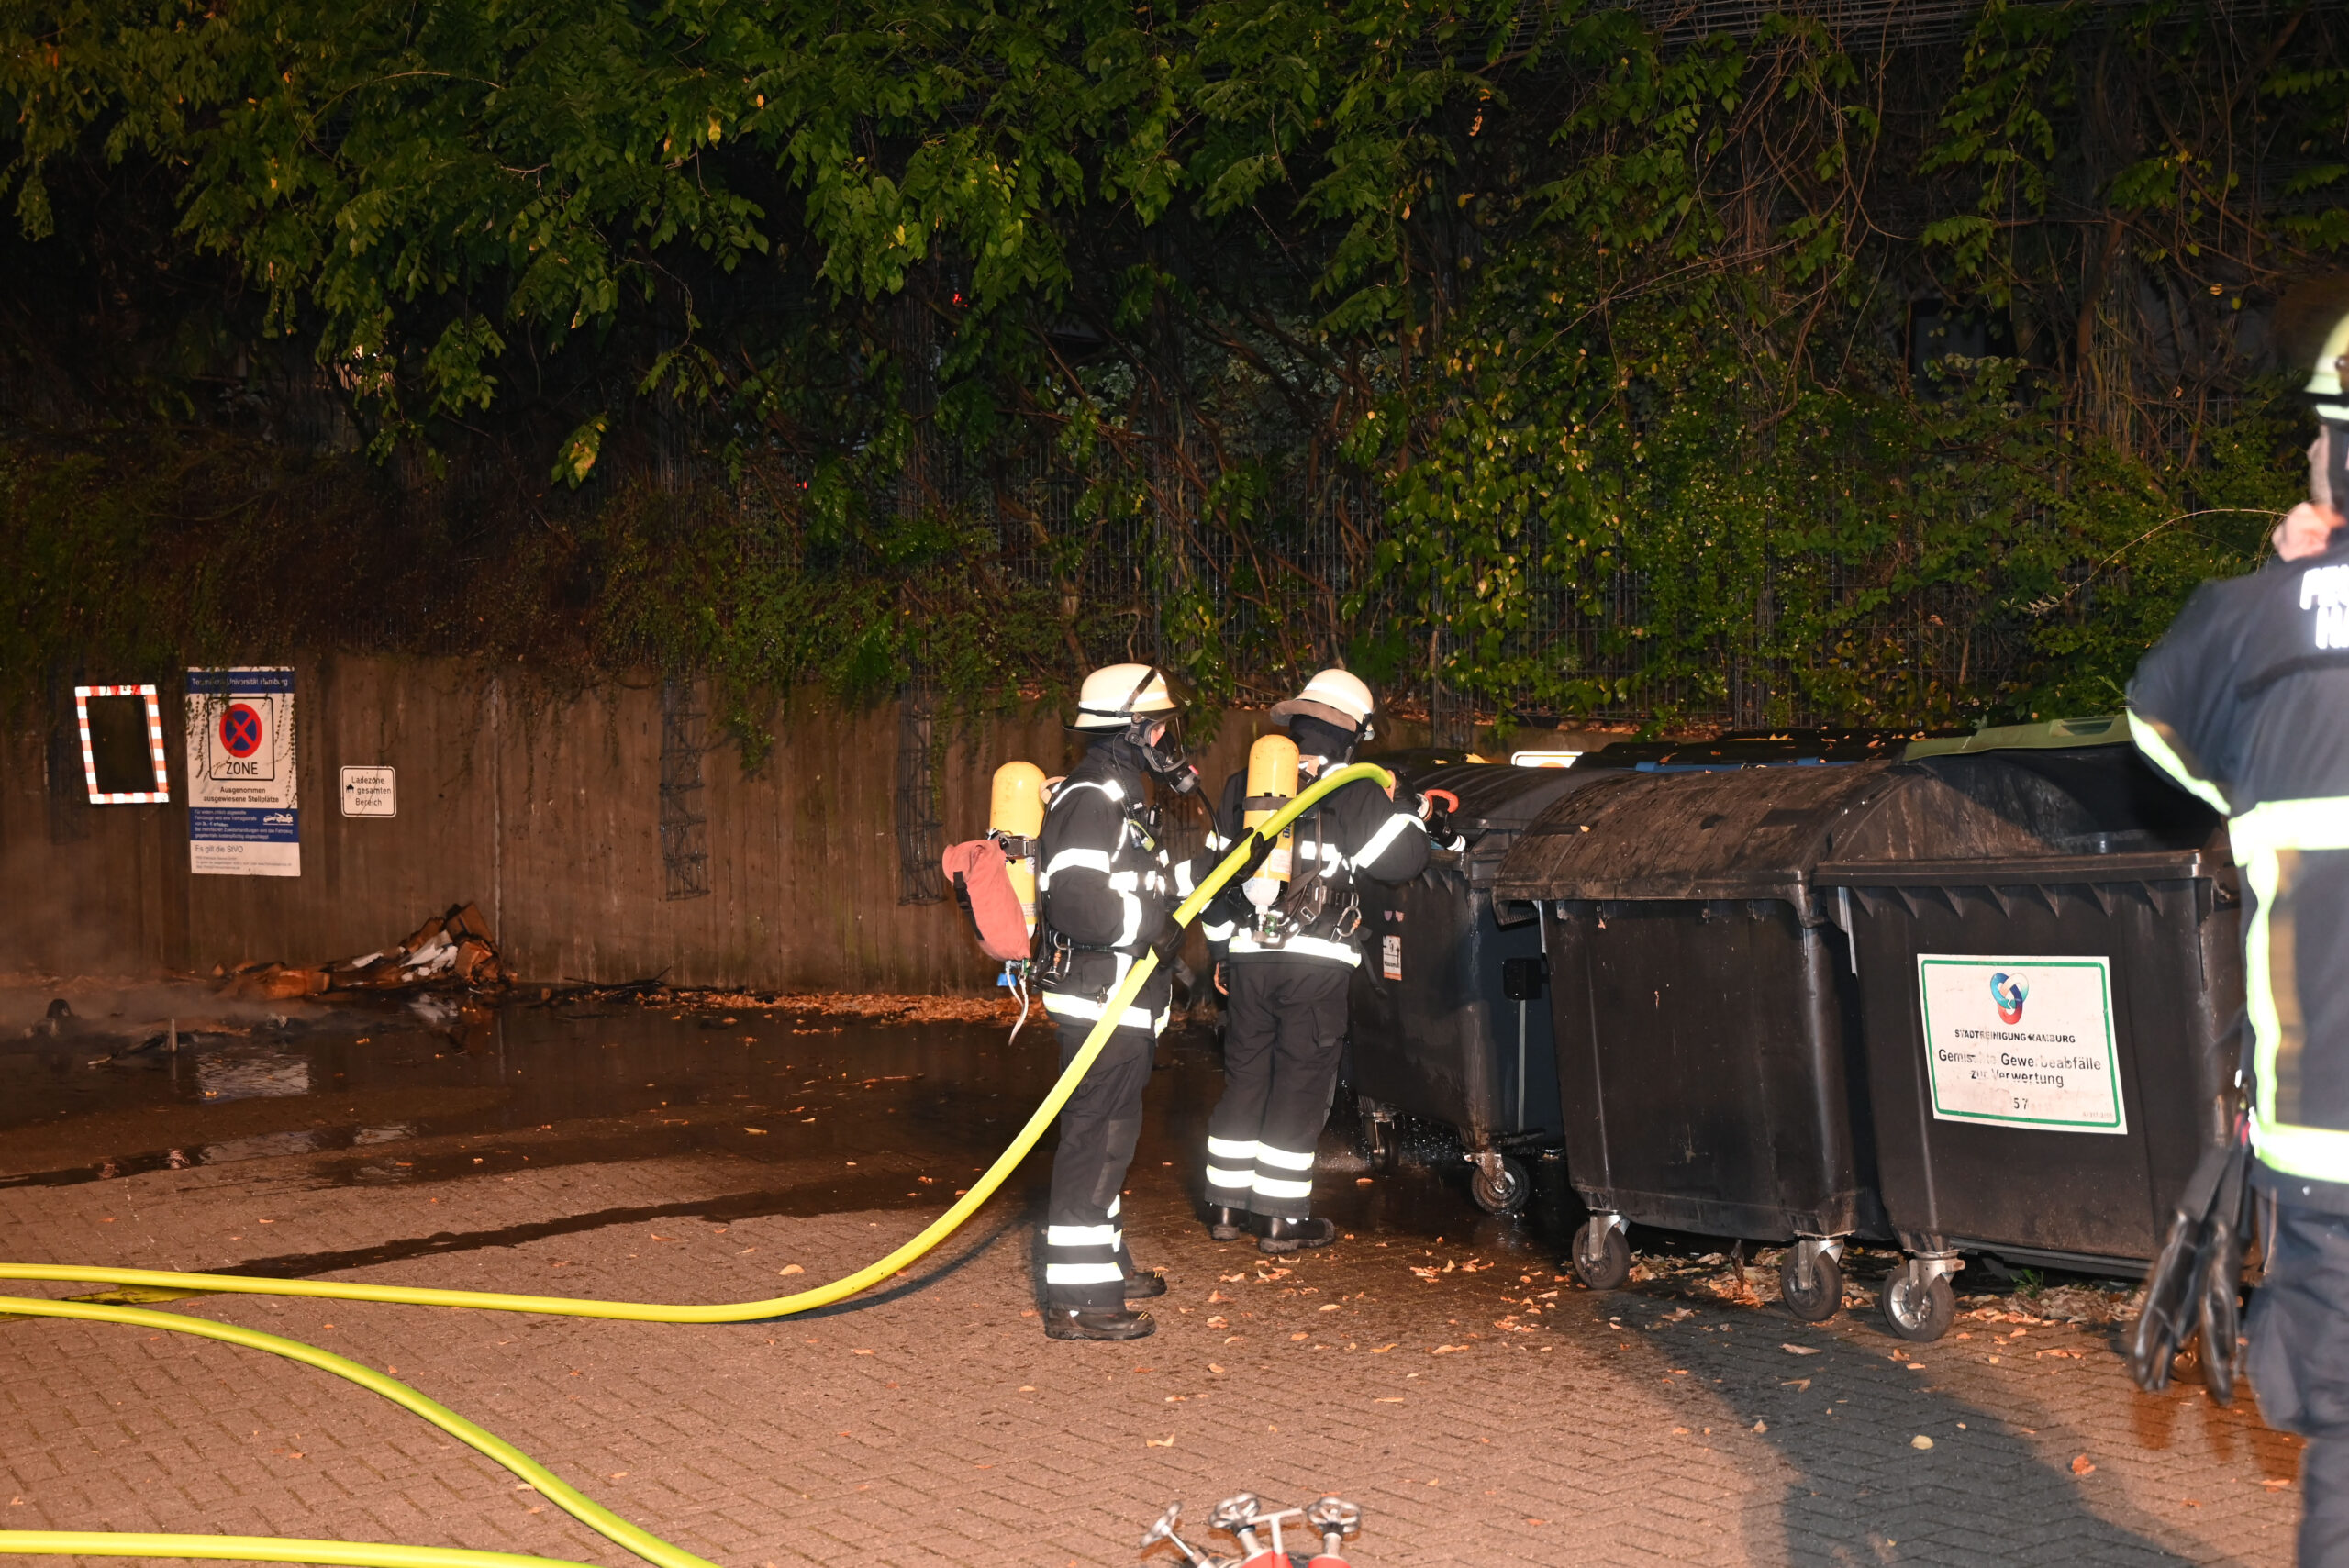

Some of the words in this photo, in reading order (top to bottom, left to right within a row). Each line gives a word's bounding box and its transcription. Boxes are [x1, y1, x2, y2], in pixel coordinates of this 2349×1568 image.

[226, 762, 259, 775] ZONE
[351, 775, 384, 784] Ladezone
[220, 786, 266, 795] Ausgenommen
[357, 787, 392, 795] gesamten
[204, 795, 247, 804] ausgewiesene
[248, 795, 280, 805] Stellplätze
[355, 797, 383, 806] Bereich
[205, 845, 215, 854] gilt
[216, 845, 226, 853] die
[227, 845, 244, 854] StVO
[1954, 1029, 2027, 1042] STADTREINIGUNG
[1938, 1049, 1997, 1064] Gemiste
[2000, 1052, 2101, 1071] Gewebeabfälle
[1992, 1068, 2065, 1088] Verwertung
